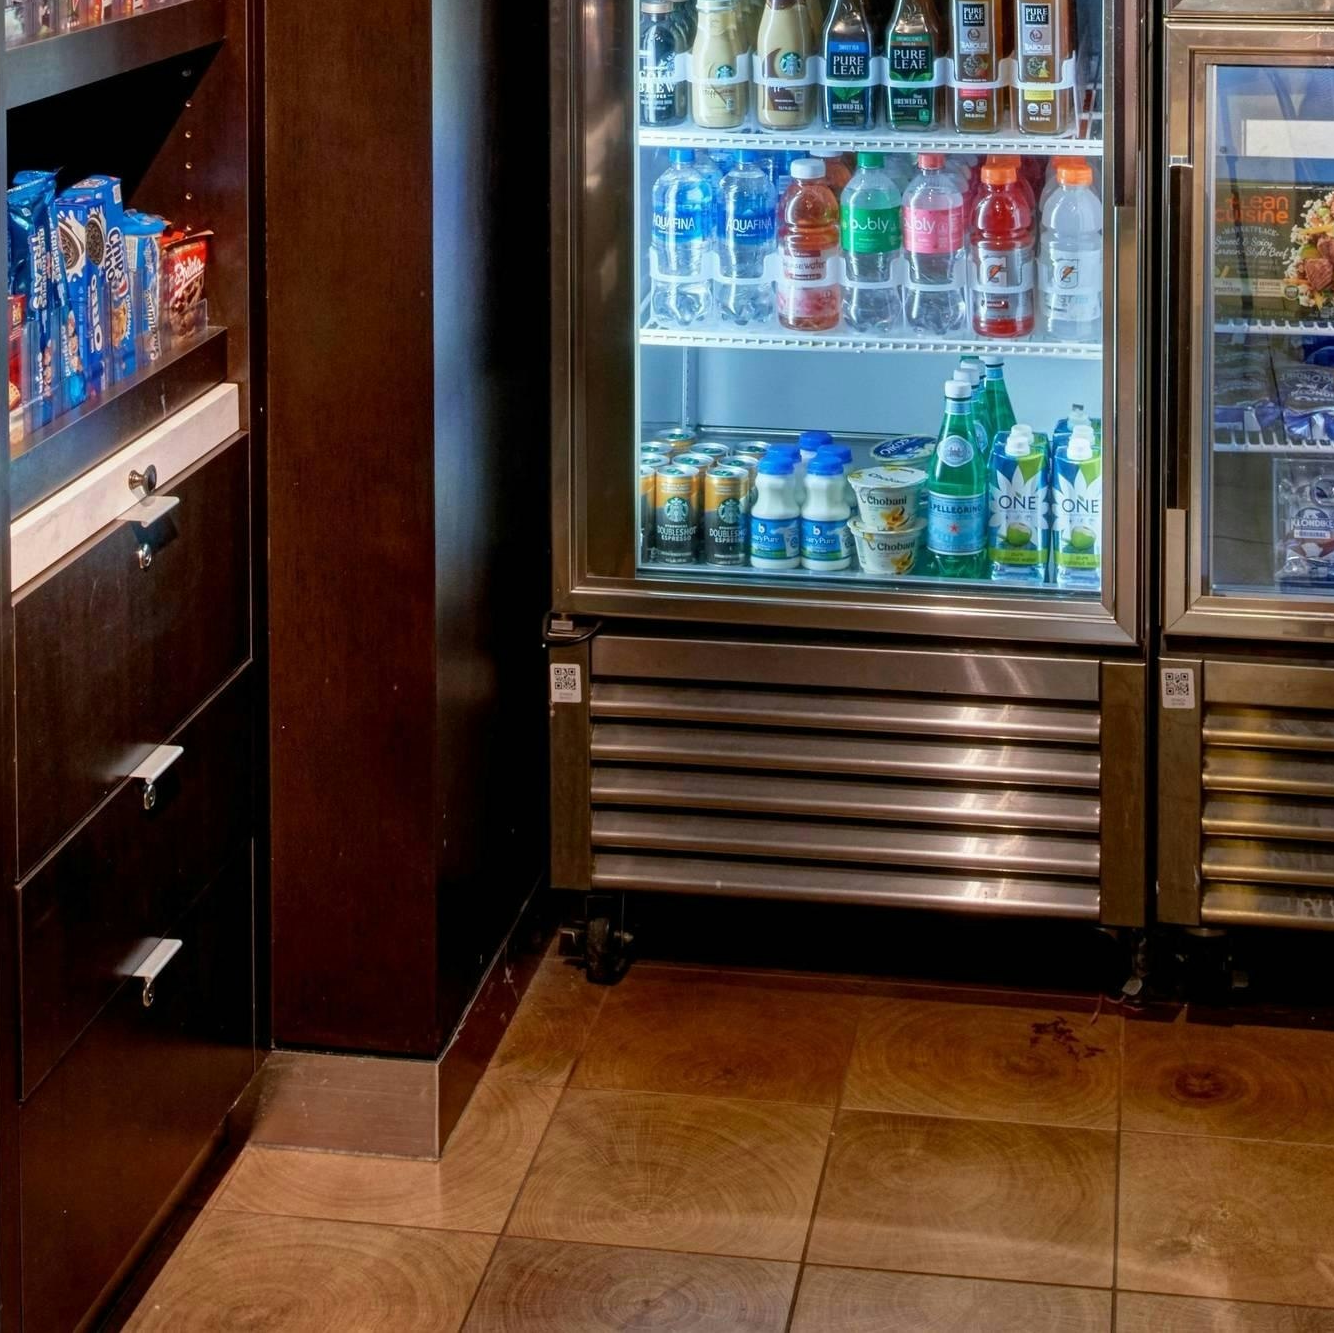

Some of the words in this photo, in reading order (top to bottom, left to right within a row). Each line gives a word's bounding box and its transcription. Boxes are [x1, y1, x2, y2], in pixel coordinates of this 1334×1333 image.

[833, 55, 864, 67] PURE
[893, 49, 926, 61] PURE
[894, 59, 926, 70] LEAF
[833, 66, 864, 76] LEAF
[652, 212, 696, 231] AQUAFINA
[726, 215, 773, 232] AQUAFINA
[1267, 246, 1290, 259] Beef
[90, 274, 103, 351] OREO
[867, 496, 908, 506] Chobani
[998, 494, 1037, 511] ONE
[1061, 497, 1100, 514] ONE
[657, 525, 698, 536] DOUBLESHOT
[877, 540, 916, 552] Chobani
